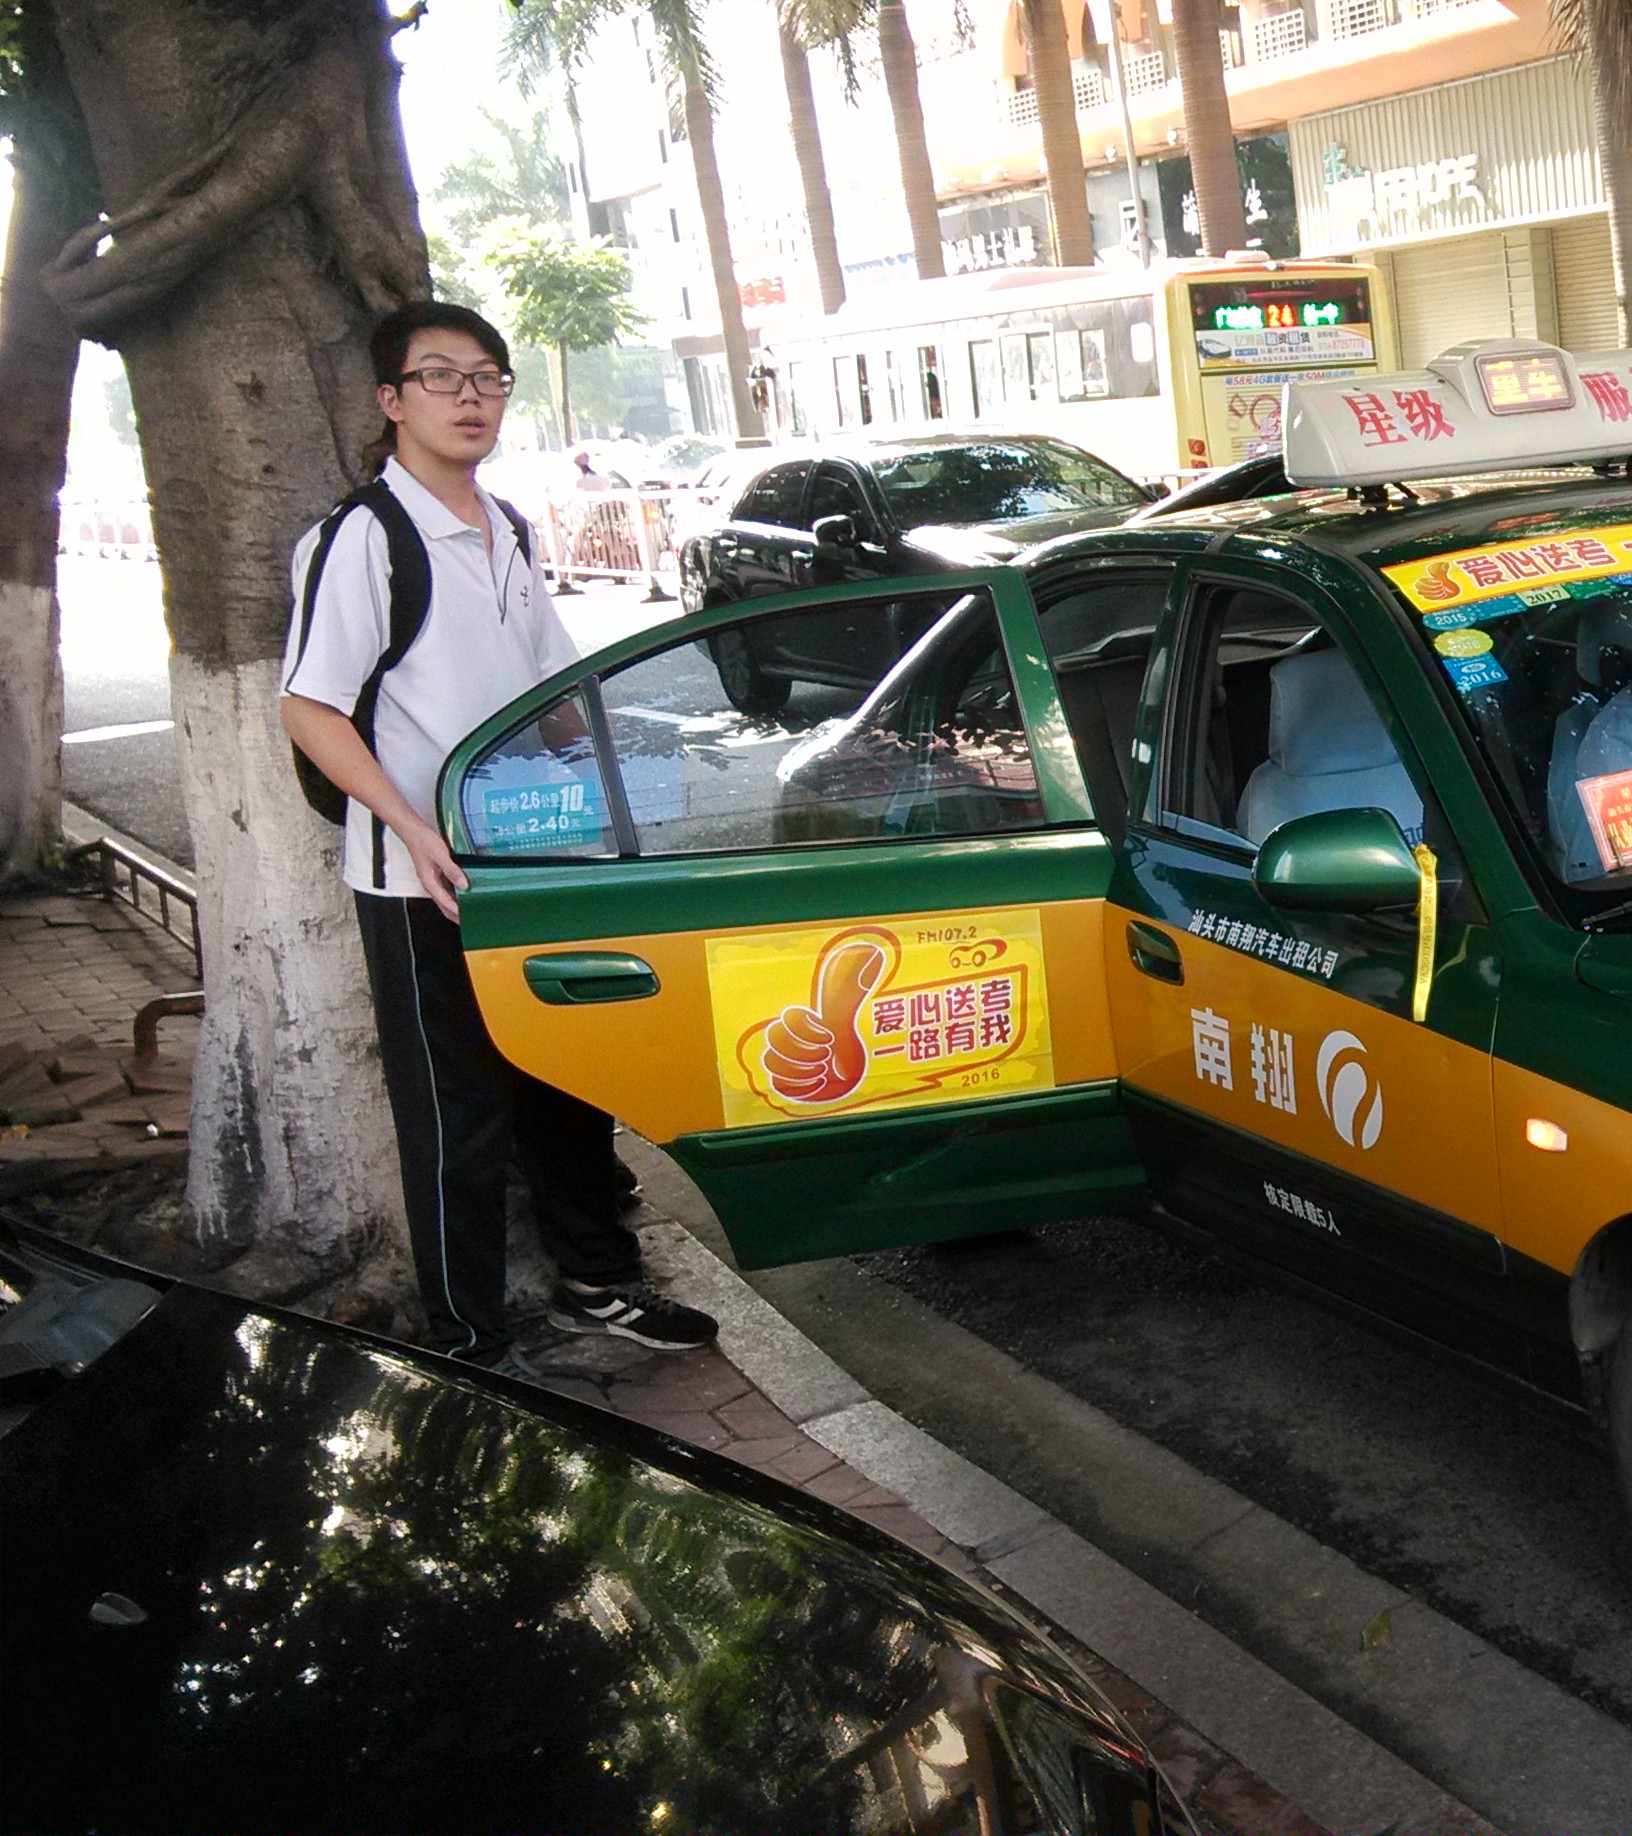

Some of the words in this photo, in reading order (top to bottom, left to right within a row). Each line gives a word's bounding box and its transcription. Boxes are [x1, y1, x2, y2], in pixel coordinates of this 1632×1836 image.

[1343, 388, 1455, 448] 星级
[1455, 537, 1618, 589] 爱心送考
[1434, 612, 1467, 626] 2015
[1526, 588, 1563, 605] 2017
[1460, 668, 1502, 687] 2016
[916, 926, 978, 944] FM107.2
[1188, 908, 1339, 979] 汕头市南翔汽车出租公司
[874, 977, 1012, 1035] 爱心送考
[874, 1013, 1012, 1063] 一路有我
[1190, 1007, 1297, 1116] 南翔
[961, 1068, 1000, 1087] 2016
